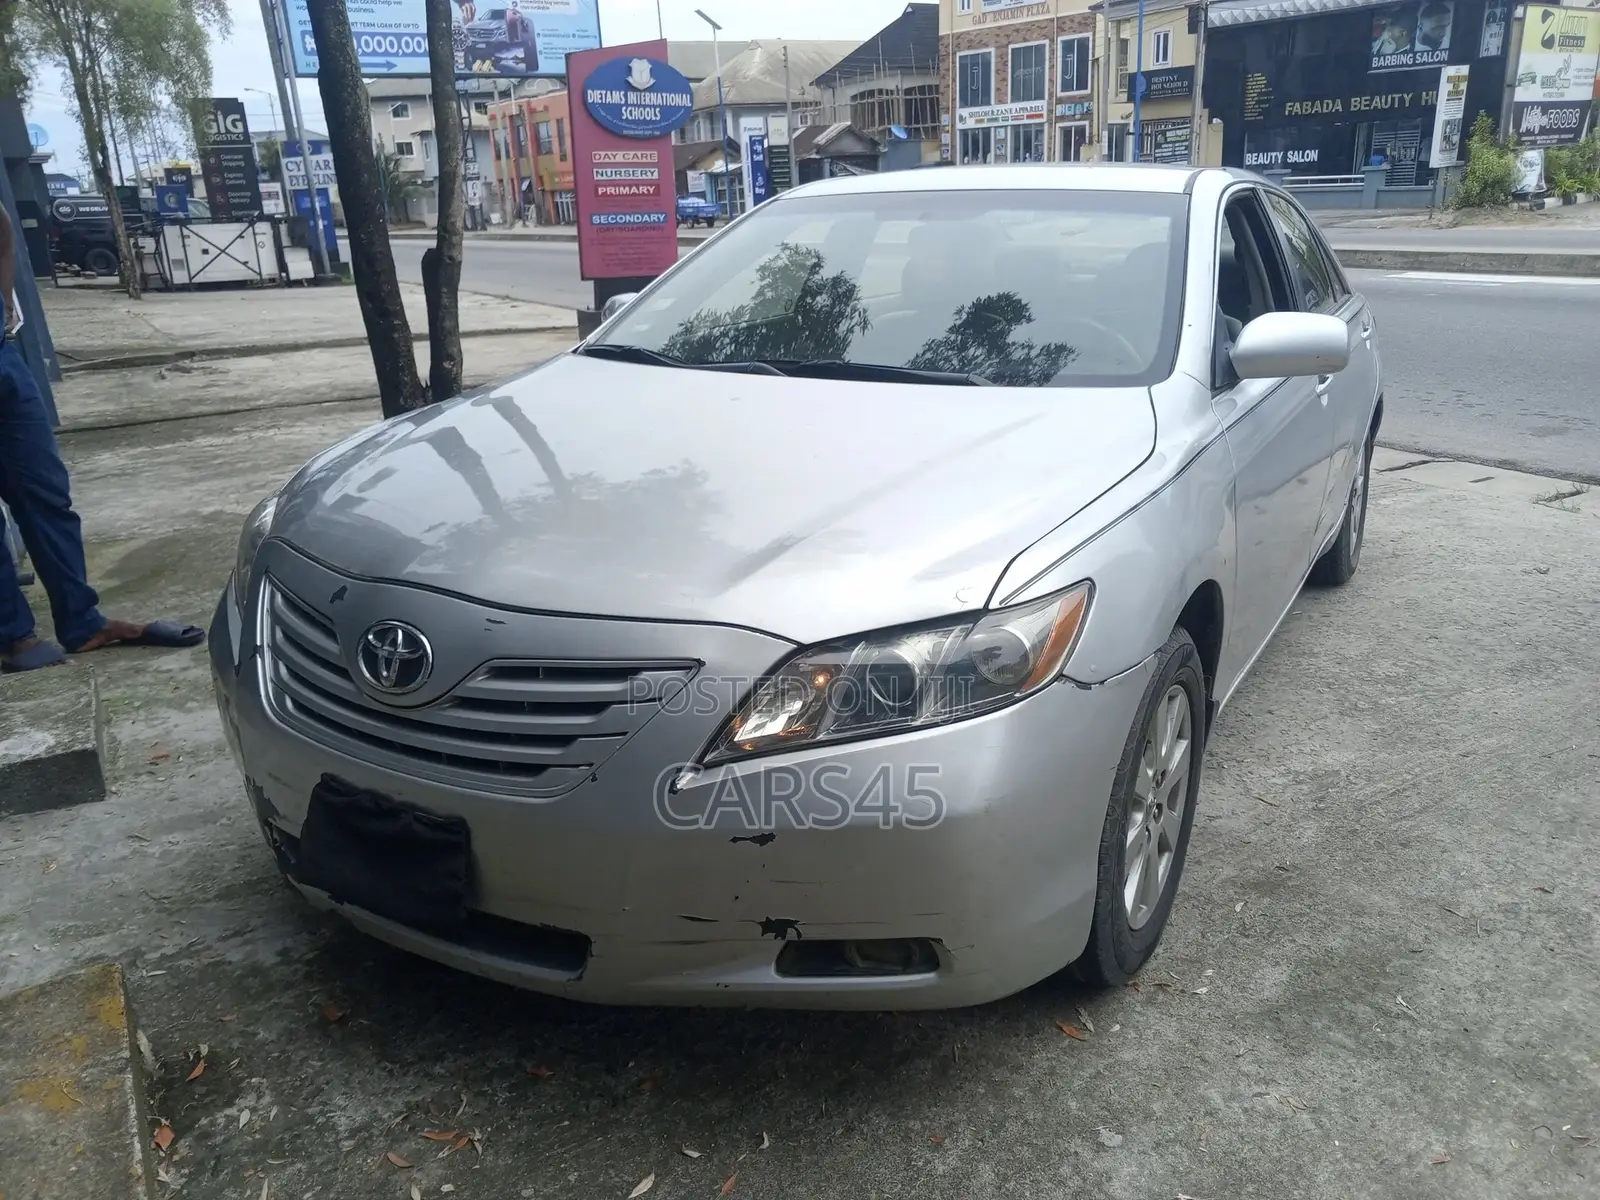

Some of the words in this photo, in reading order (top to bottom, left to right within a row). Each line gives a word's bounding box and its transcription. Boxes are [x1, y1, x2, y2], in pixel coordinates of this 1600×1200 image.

[972, 14, 987, 25] GAD
[1026, 3, 1051, 18] PLAZA
[1559, 36, 1584, 46] Fitness
[1371, 53, 1414, 68] BARBING
[1415, 50, 1449, 63] SALON
[1151, 75, 1179, 84] DESTINY
[587, 89, 625, 105] DIETAMS
[627, 90, 692, 107] INTERNATIONAL
[1285, 99, 1342, 116] FABADA
[1350, 92, 1414, 111] BEAUTY
[1420, 90, 1438, 106] HU
[621, 106, 661, 121] SCHOOLS
[1545, 108, 1580, 129] FOODS
[593, 152, 619, 161] DAY
[622, 152, 658, 161] CARE
[1245, 151, 1284, 166] BEAUTY
[1286, 149, 1319, 164] SALON
[595, 169, 657, 178] NURSERY
[598, 186, 656, 196] PRIMARY
[592, 214, 666, 224] SECONDARY
